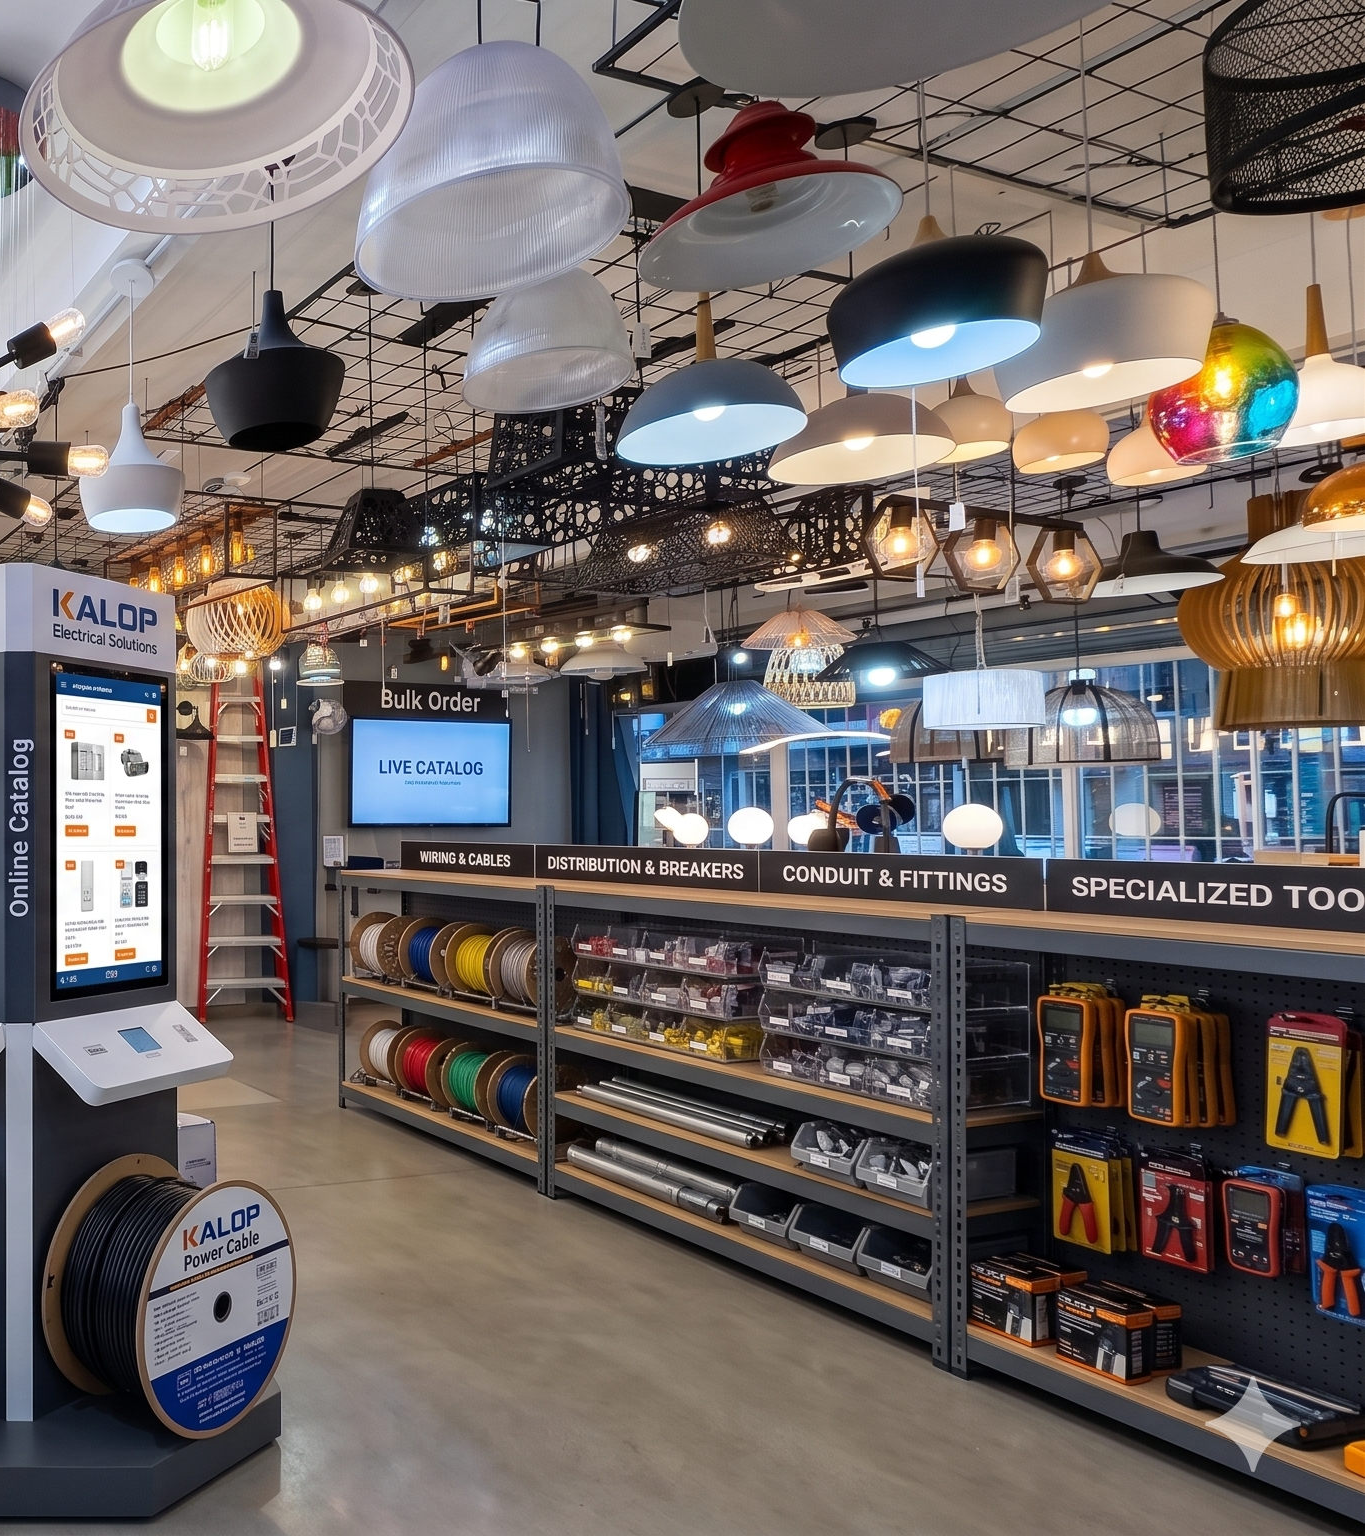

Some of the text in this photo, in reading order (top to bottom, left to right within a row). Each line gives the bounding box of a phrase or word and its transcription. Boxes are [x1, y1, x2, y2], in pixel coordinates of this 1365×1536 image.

[52, 588, 158, 633] KALOP
[53, 623, 158, 655] Electrical Solutions
[381, 688, 481, 712] Bulk Order
[379, 760, 484, 776] LIVE CATALOG
[8, 739, 35, 918] Online Catalog
[420, 850, 511, 868] WIRING & CABLES
[547, 855, 744, 880] DISTRIBUTION & BREAKERS
[782, 864, 1008, 893] CONDUIT & FITTINGS
[1071, 876, 1273, 907] SPECIALIZED
[182, 1203, 261, 1251] KALOP
[184, 1230, 260, 1272] Power Cable
